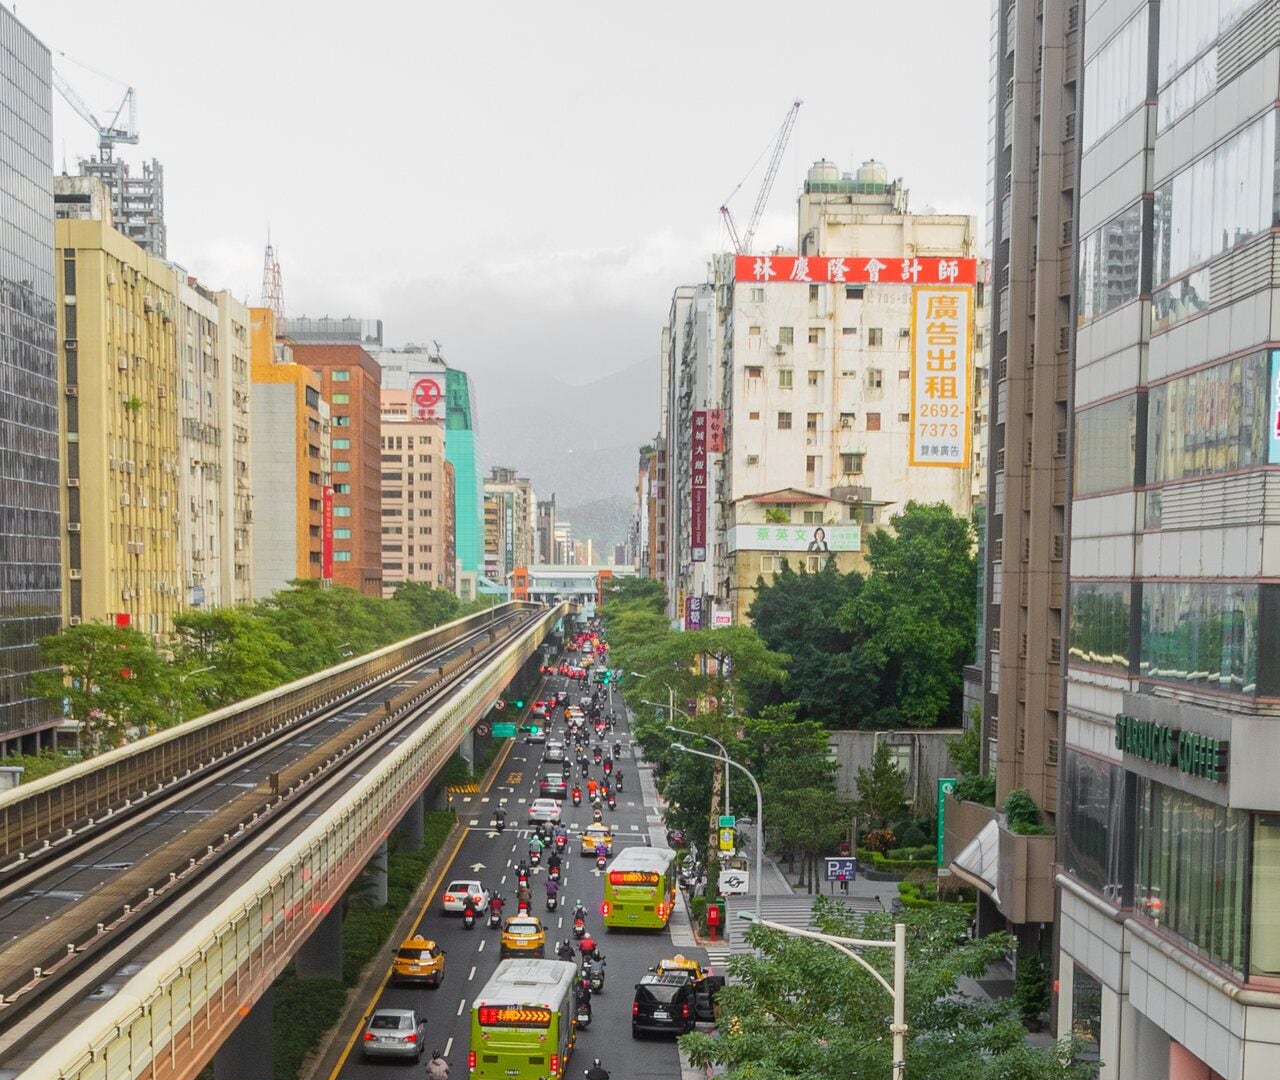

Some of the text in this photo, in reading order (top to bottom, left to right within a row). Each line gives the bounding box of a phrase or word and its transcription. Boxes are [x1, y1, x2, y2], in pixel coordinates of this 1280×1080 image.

[753, 257, 960, 283] 林慶隆會計師
[925, 295, 958, 400] 廣告出租
[919, 423, 958, 438] 7373
[757, 528, 807, 541] 蔡英文
[1115, 713, 1220, 783] STARBUCKS COFFEE
